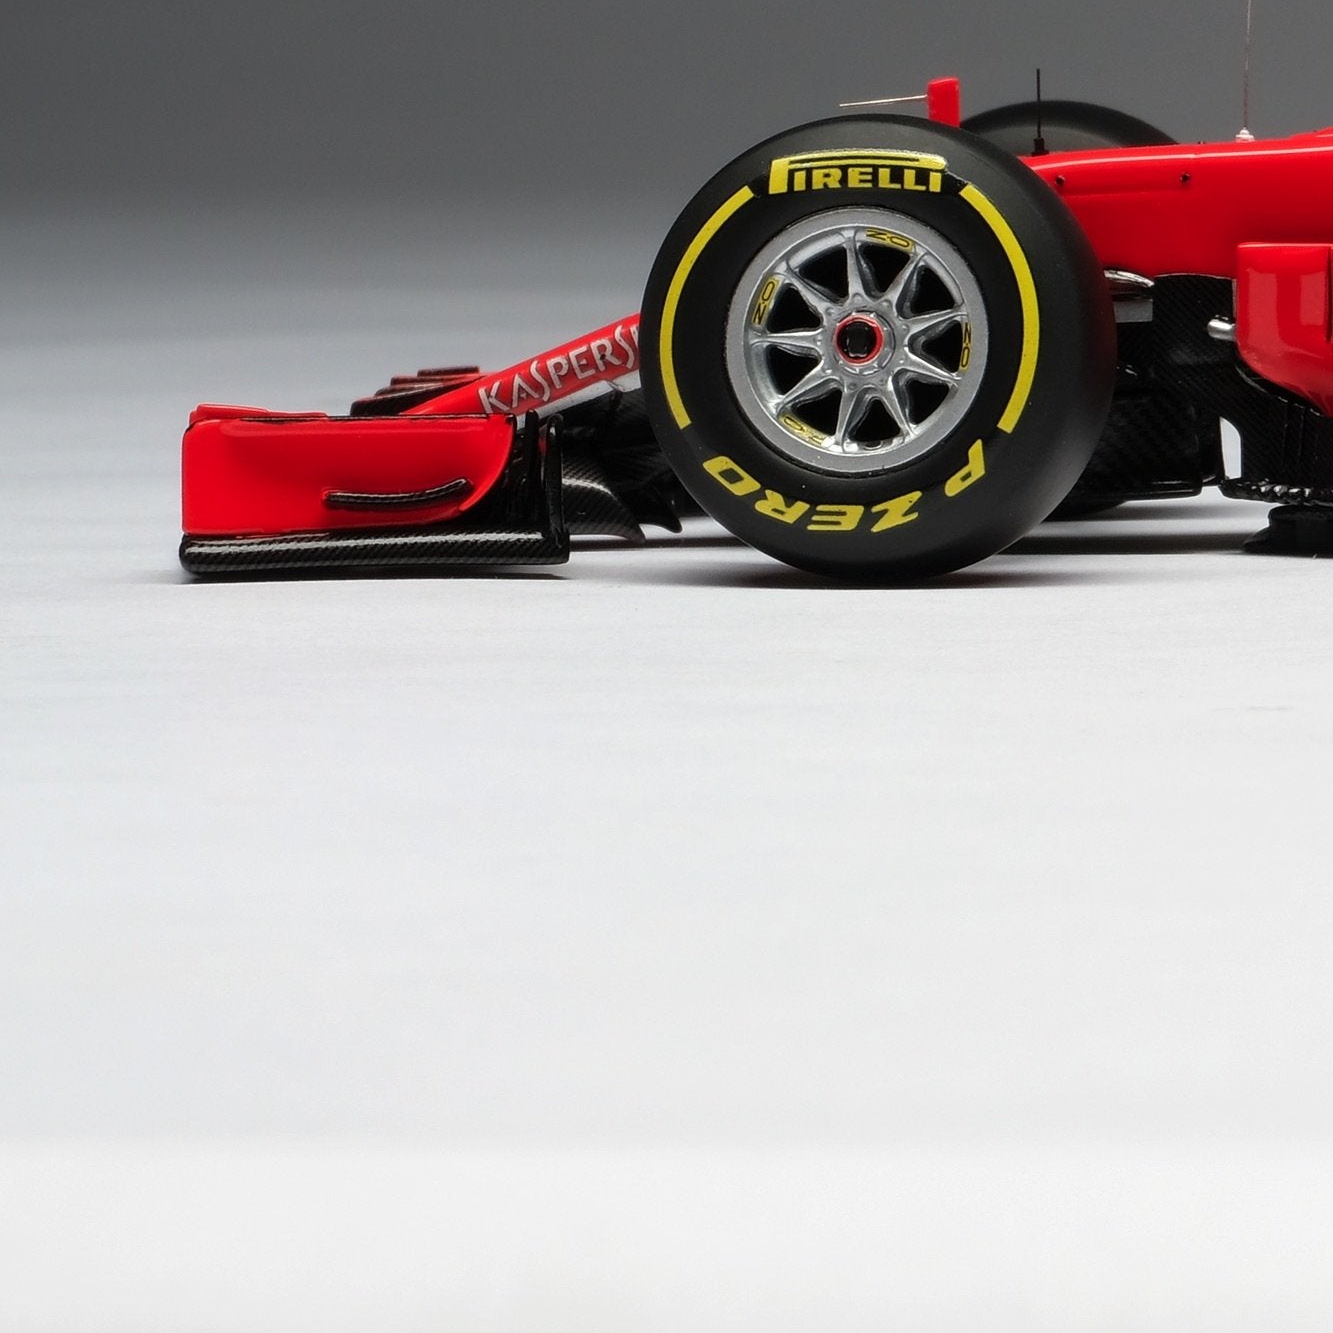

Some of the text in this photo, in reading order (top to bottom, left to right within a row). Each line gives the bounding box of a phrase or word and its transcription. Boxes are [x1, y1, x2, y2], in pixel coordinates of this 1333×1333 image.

[768, 147, 947, 194] PIRELLI
[702, 438, 986, 533] P ZERO
